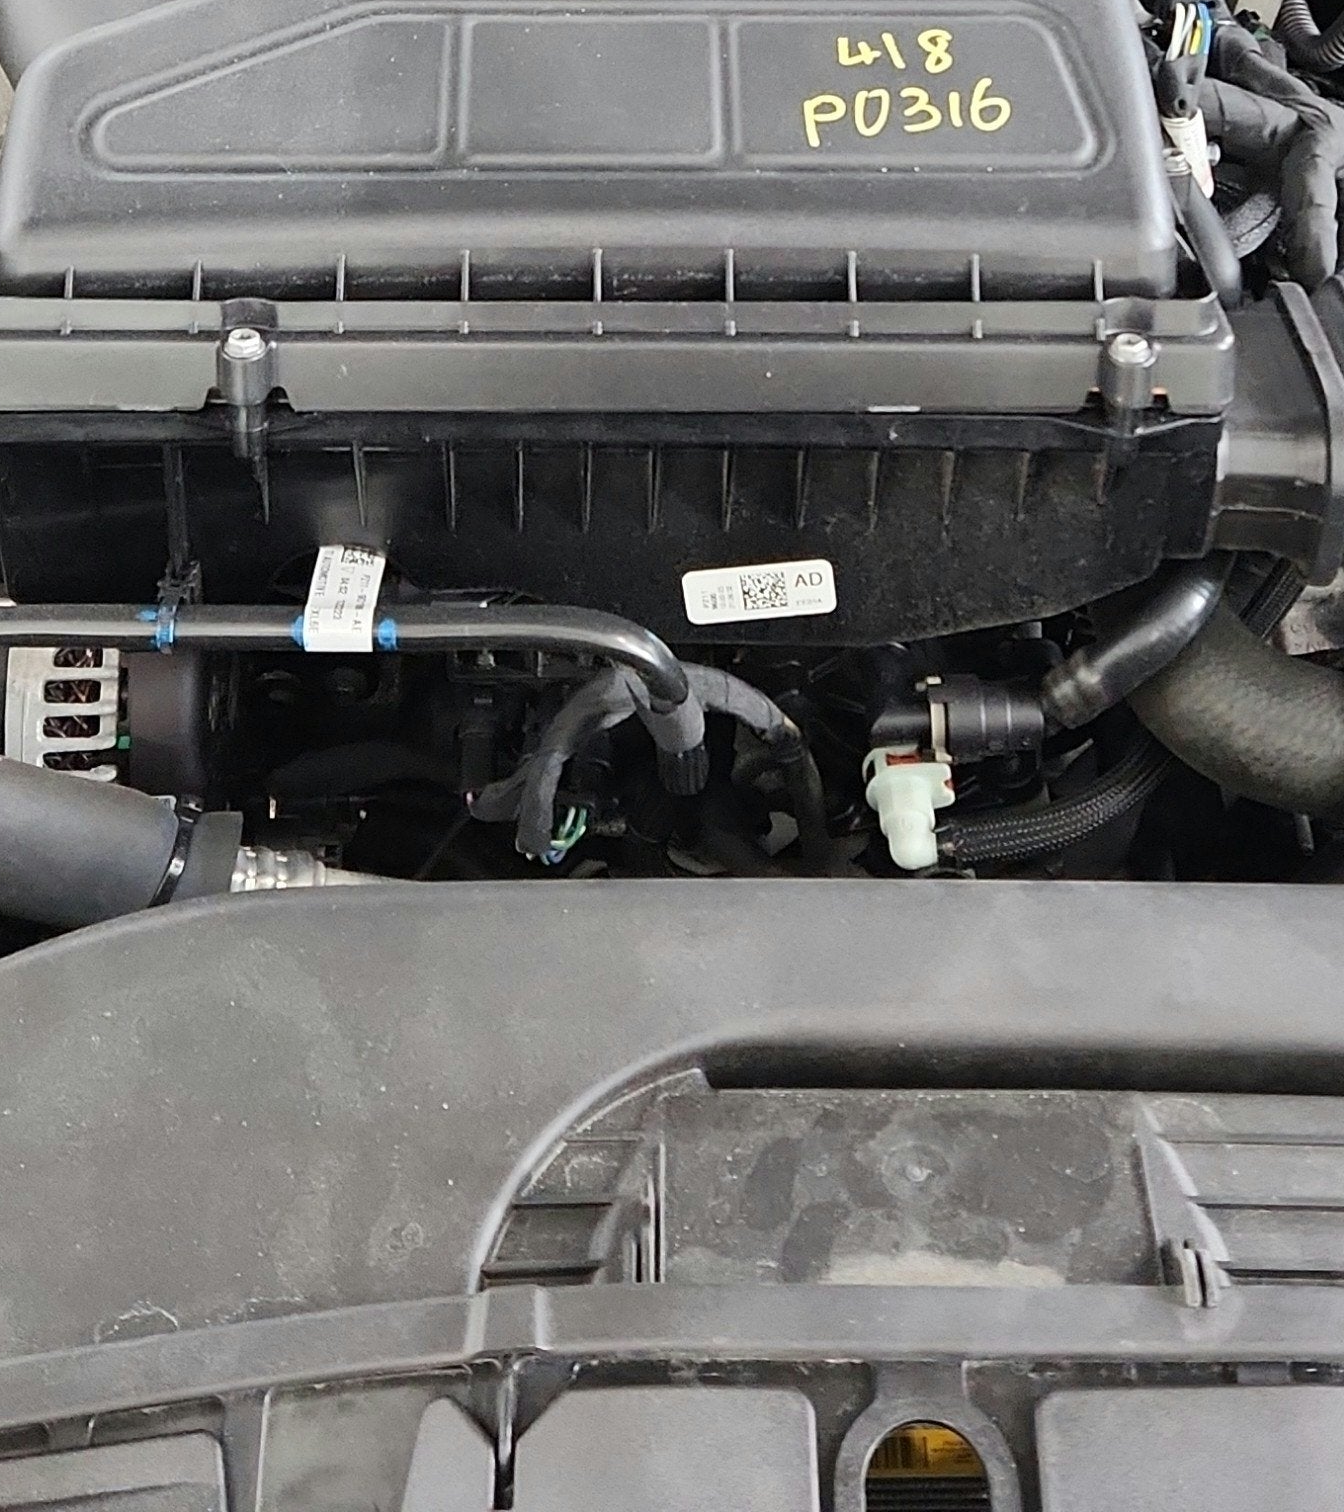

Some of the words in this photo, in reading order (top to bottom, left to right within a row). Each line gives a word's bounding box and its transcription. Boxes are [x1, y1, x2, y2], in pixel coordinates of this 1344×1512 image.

[837, 28, 954, 74] 418
[803, 77, 1012, 148] P0316
[794, 571, 823, 588] AD
